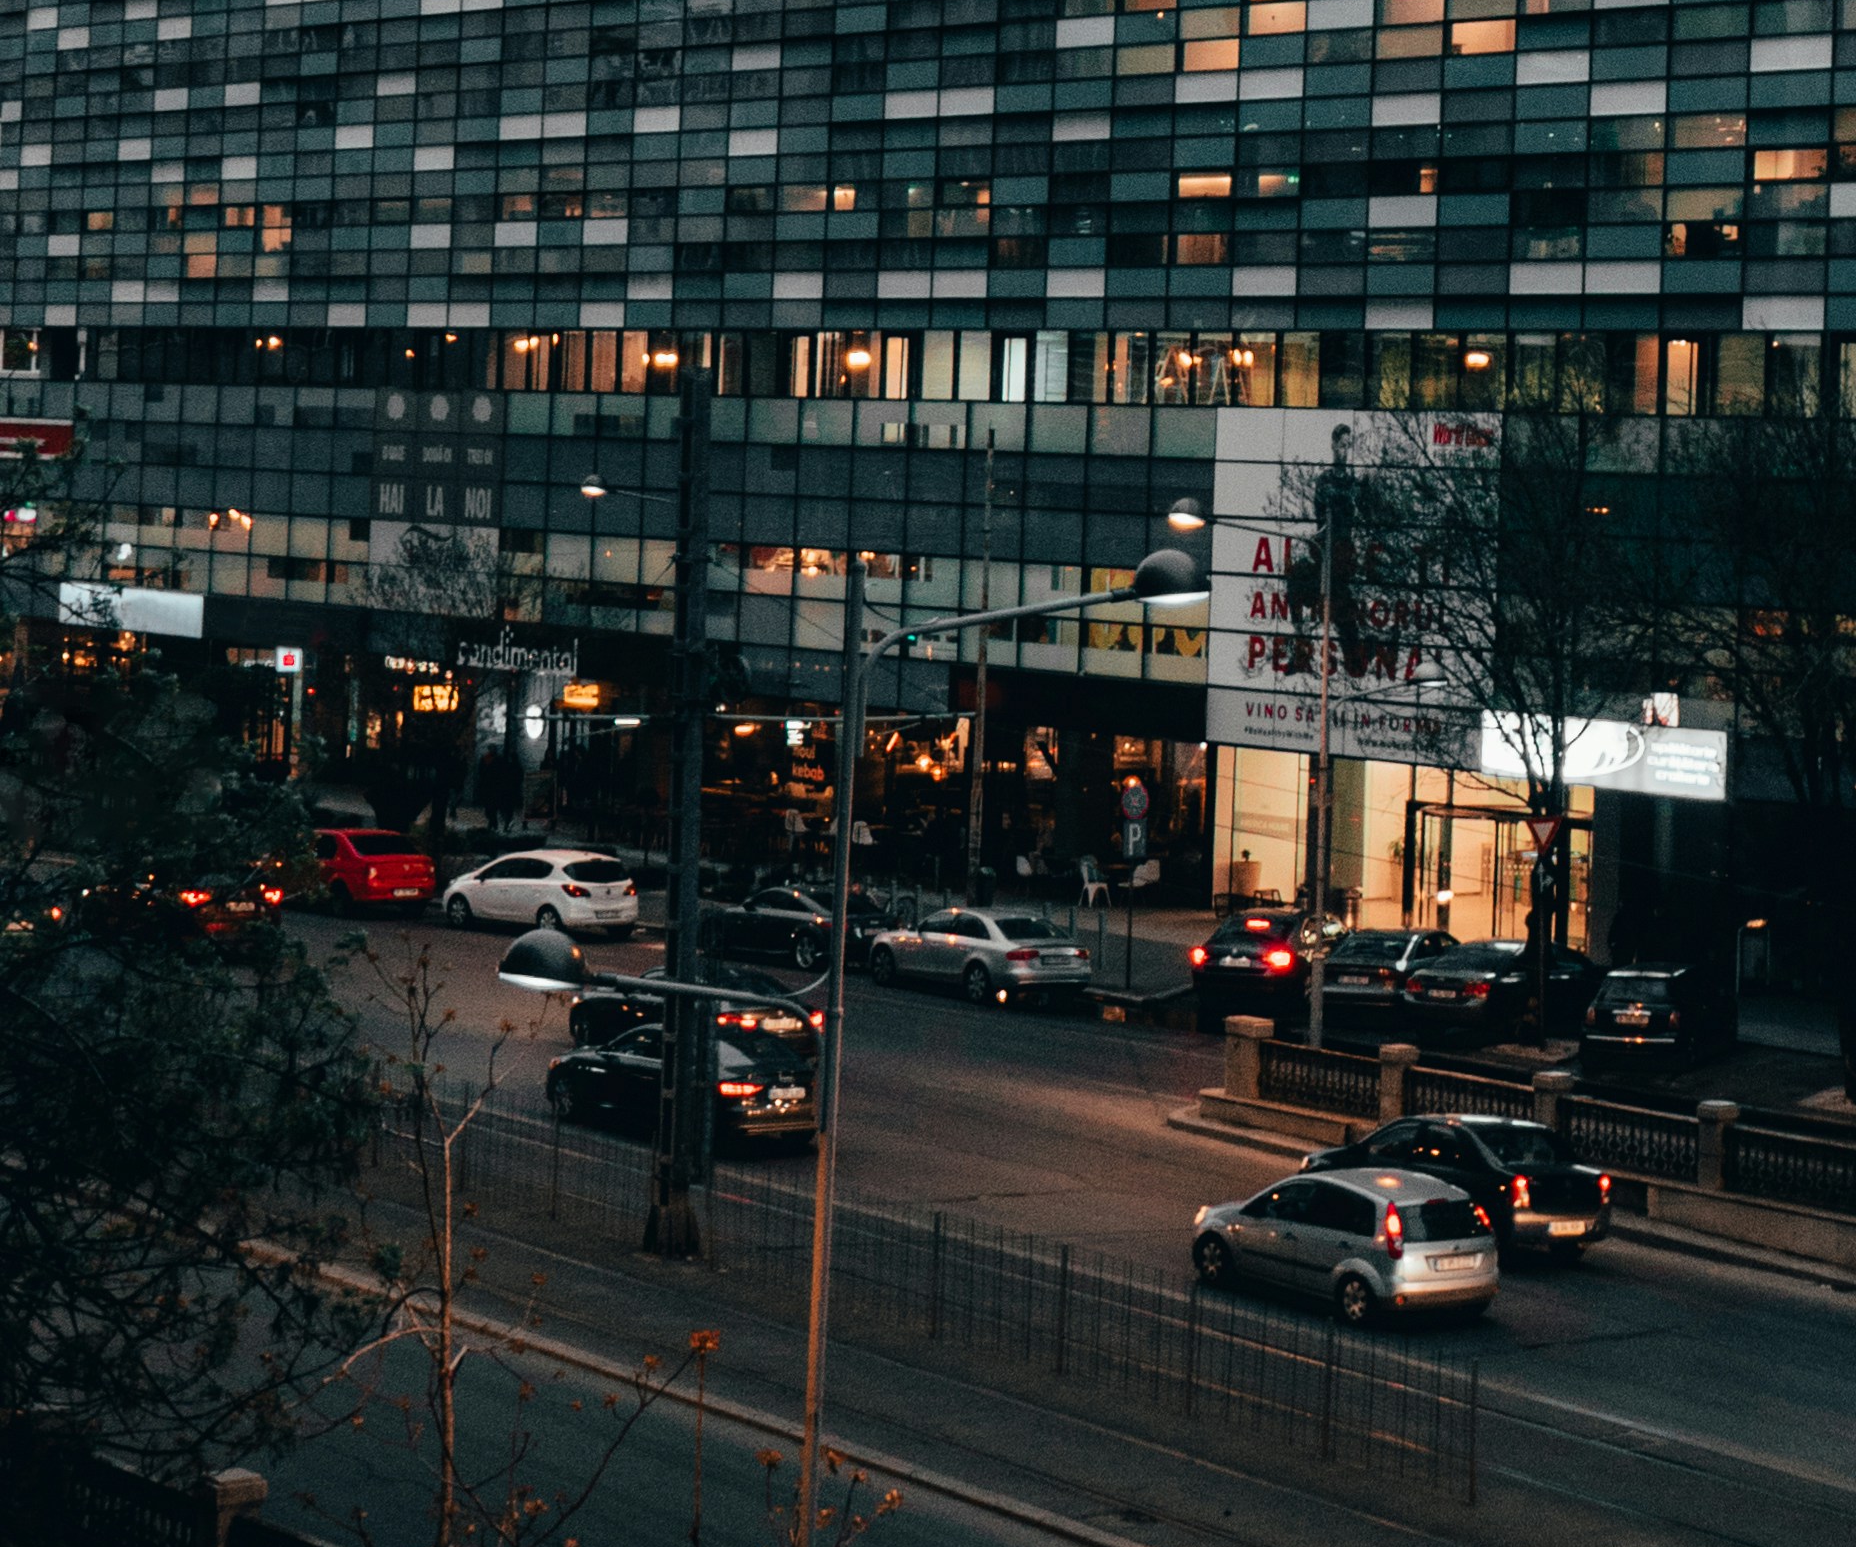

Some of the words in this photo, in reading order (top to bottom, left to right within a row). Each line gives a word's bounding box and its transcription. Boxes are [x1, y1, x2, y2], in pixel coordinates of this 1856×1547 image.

[379, 483, 405, 514] HAI
[426, 485, 445, 517] LA
[464, 487, 493, 520] NOI
[1246, 702, 1288, 720] VINO
[792, 763, 826, 783] kebab
[1128, 822, 1142, 856] P
